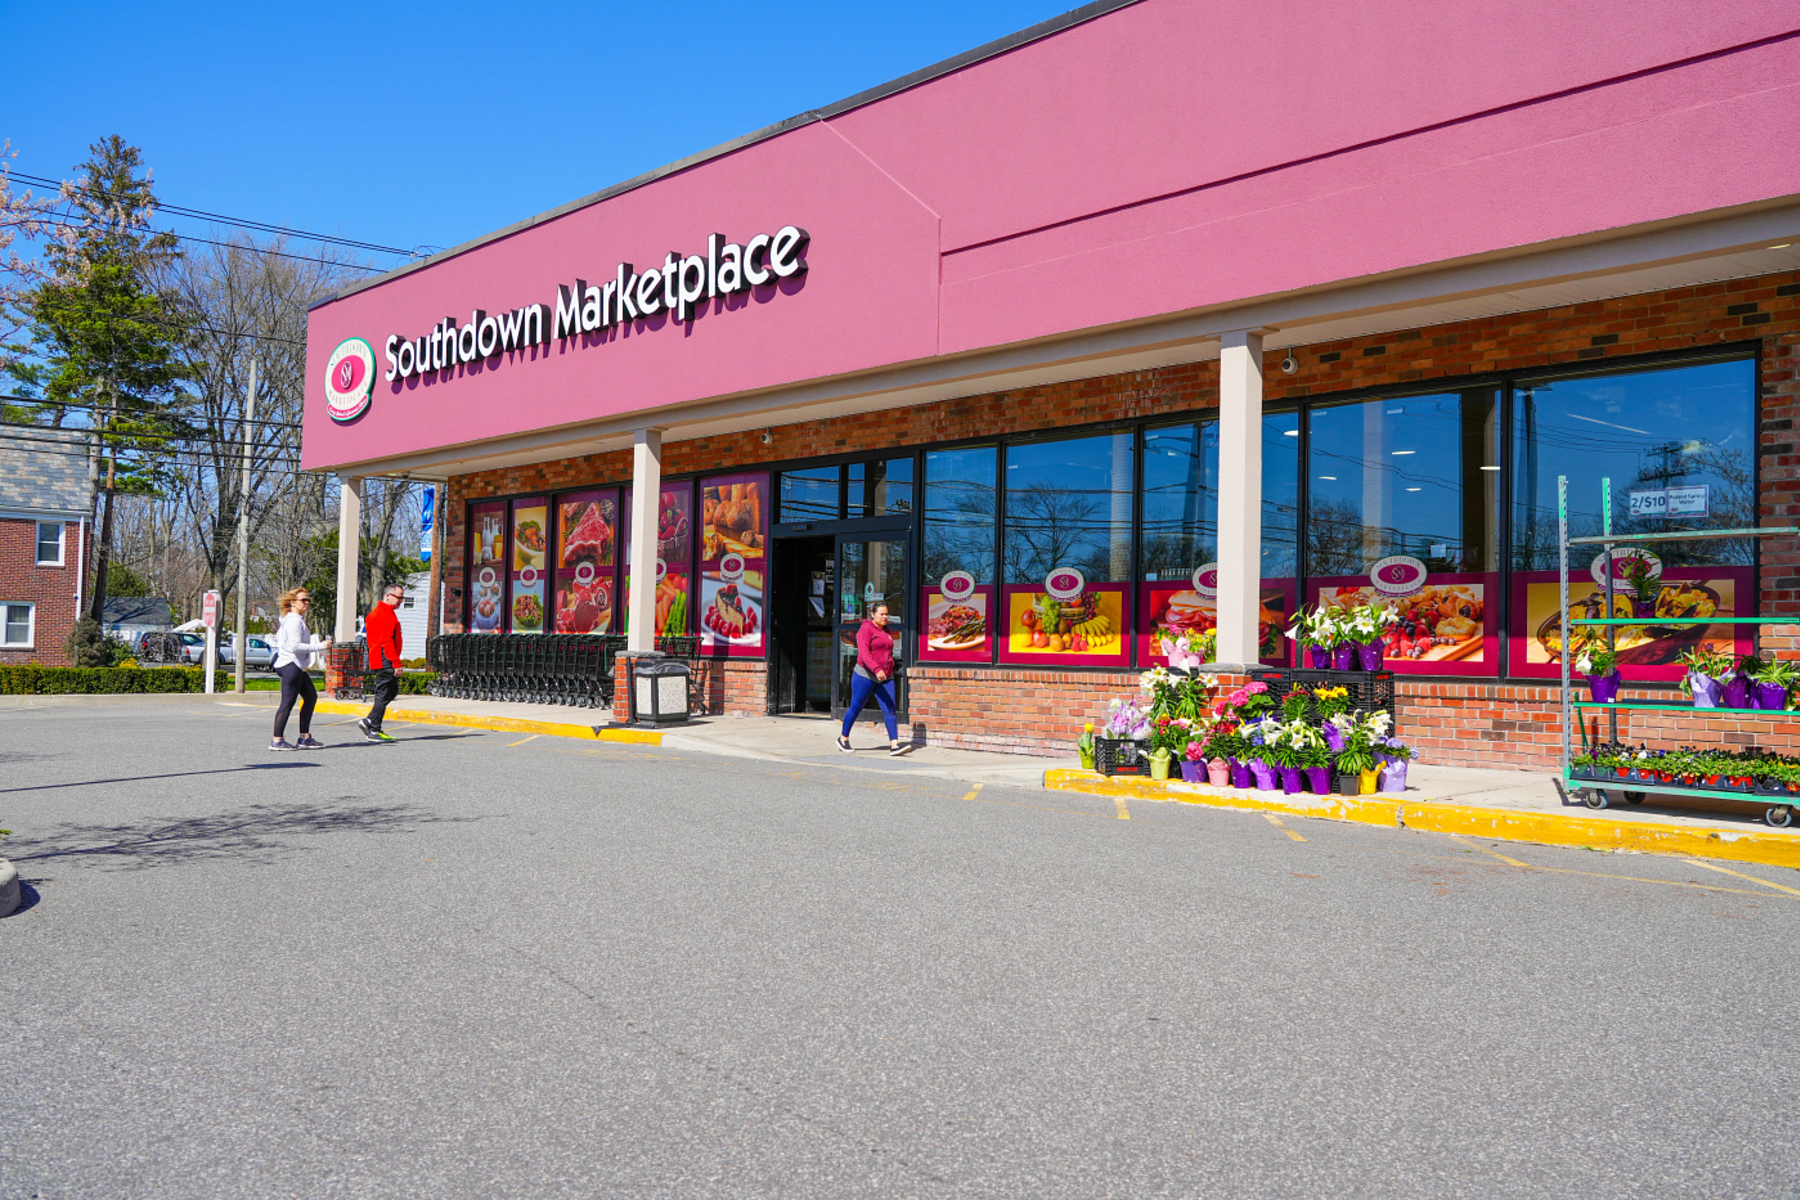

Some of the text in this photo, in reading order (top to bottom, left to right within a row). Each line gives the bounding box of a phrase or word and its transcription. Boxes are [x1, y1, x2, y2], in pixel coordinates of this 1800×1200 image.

[385, 225, 802, 382] Southdown Marketplace
[1631, 496, 1666, 509] 2/$10
